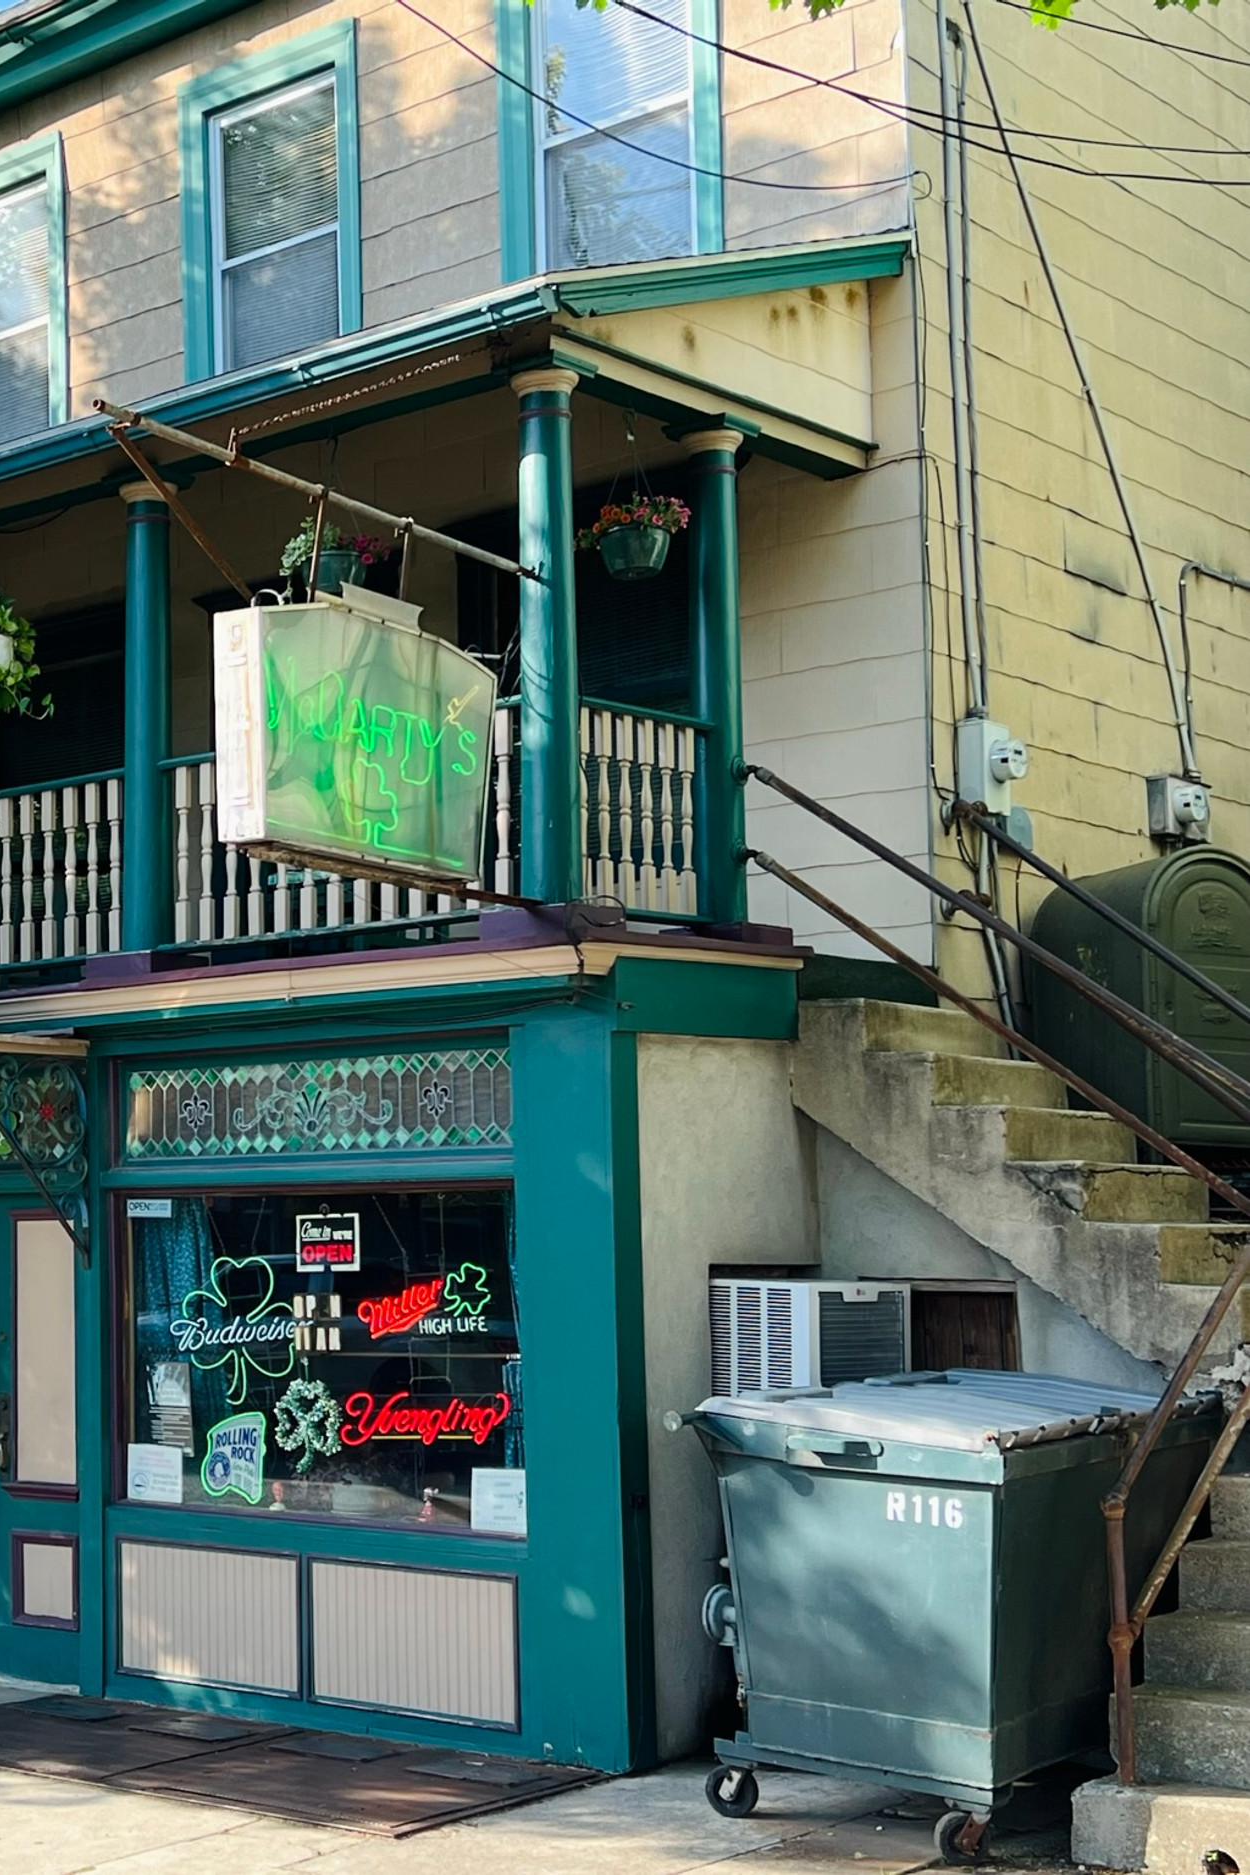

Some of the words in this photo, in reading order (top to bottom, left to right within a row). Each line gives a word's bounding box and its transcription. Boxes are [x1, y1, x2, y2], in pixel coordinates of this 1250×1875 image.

[302, 1244, 353, 1263] OPEN
[294, 1295, 341, 1318] OPN
[357, 1279, 444, 1333] Miller
[418, 1318, 452, 1334] HIGH
[456, 1316, 488, 1332] LIFE
[341, 1391, 512, 1446] Yuengling
[216, 1427, 257, 1448] ROLLING
[230, 1446, 255, 1464] ROCK
[886, 1491, 963, 1529] R116
